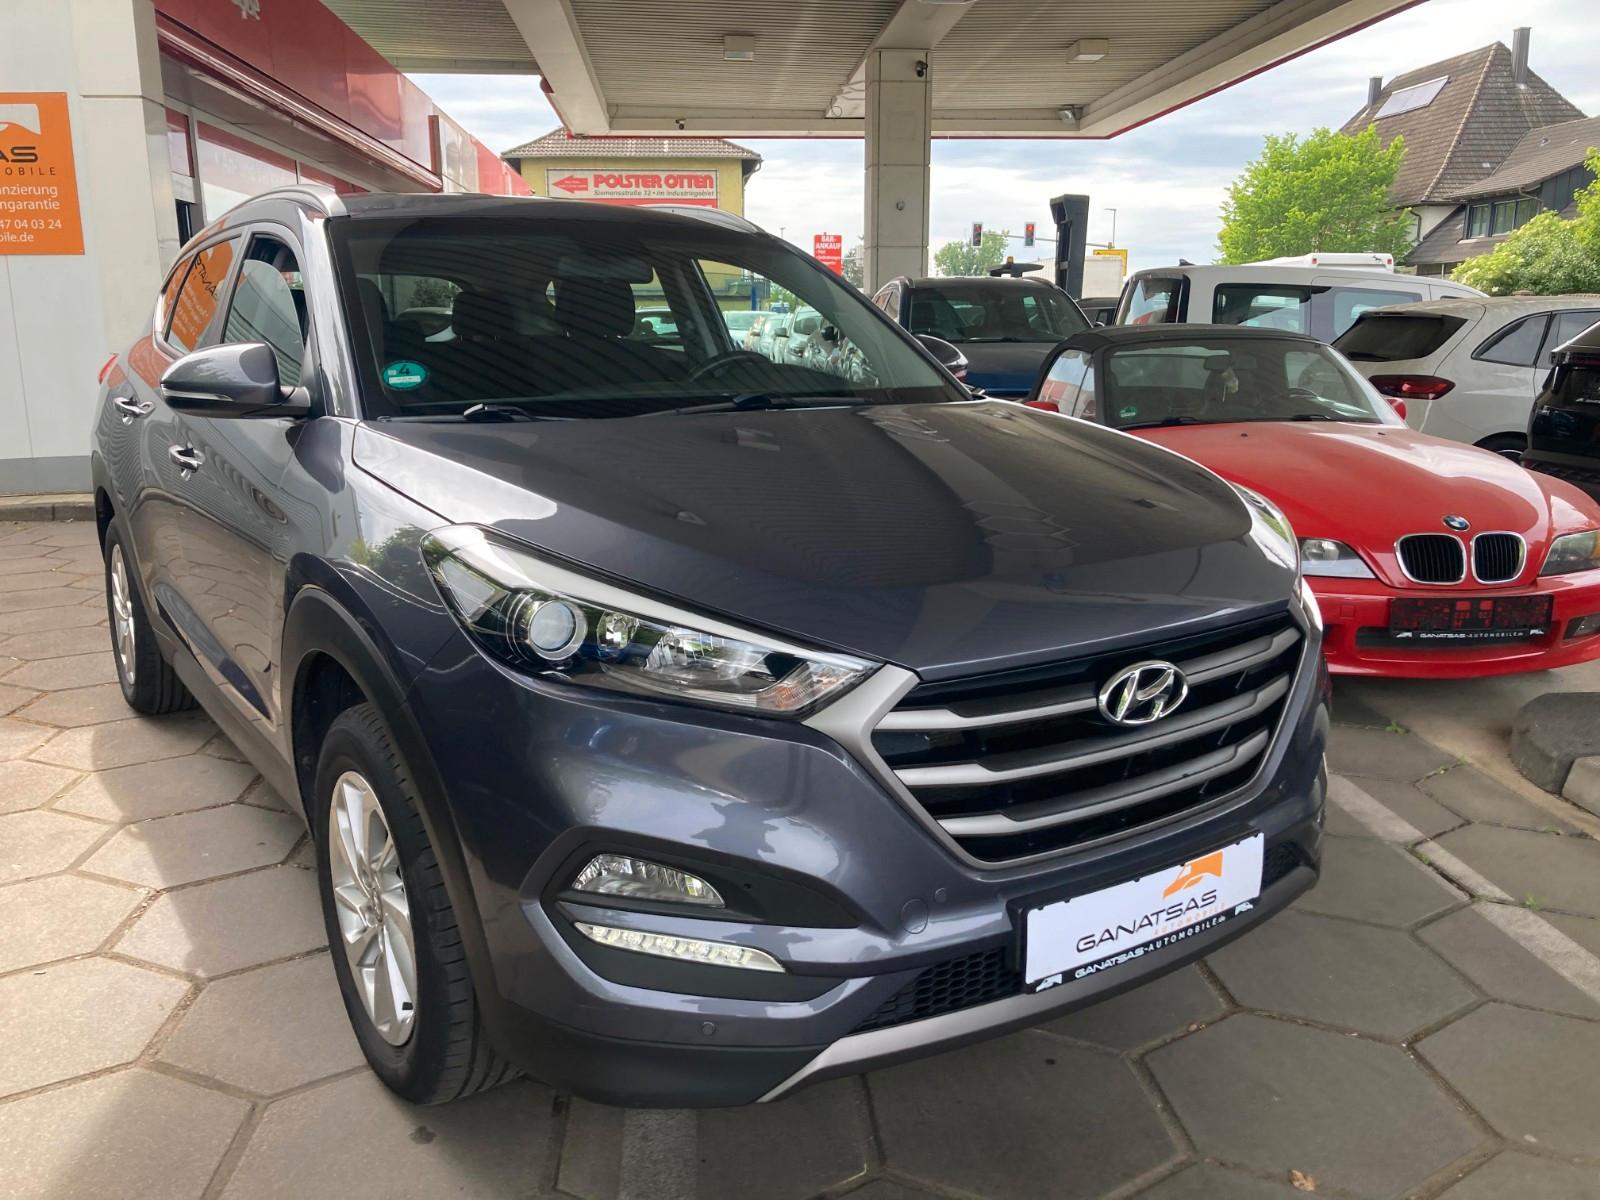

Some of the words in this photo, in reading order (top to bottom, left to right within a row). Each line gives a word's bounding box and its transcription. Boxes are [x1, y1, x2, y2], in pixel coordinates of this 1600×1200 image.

[593, 174, 662, 189] POLSTER
[664, 174, 714, 189] OTTEN
[14, 219, 29, 229] 04
[31, 219, 45, 229] 03
[48, 219, 62, 229] 24
[399, 364, 410, 375] 4
[1076, 889, 1217, 953] GANATSAS
